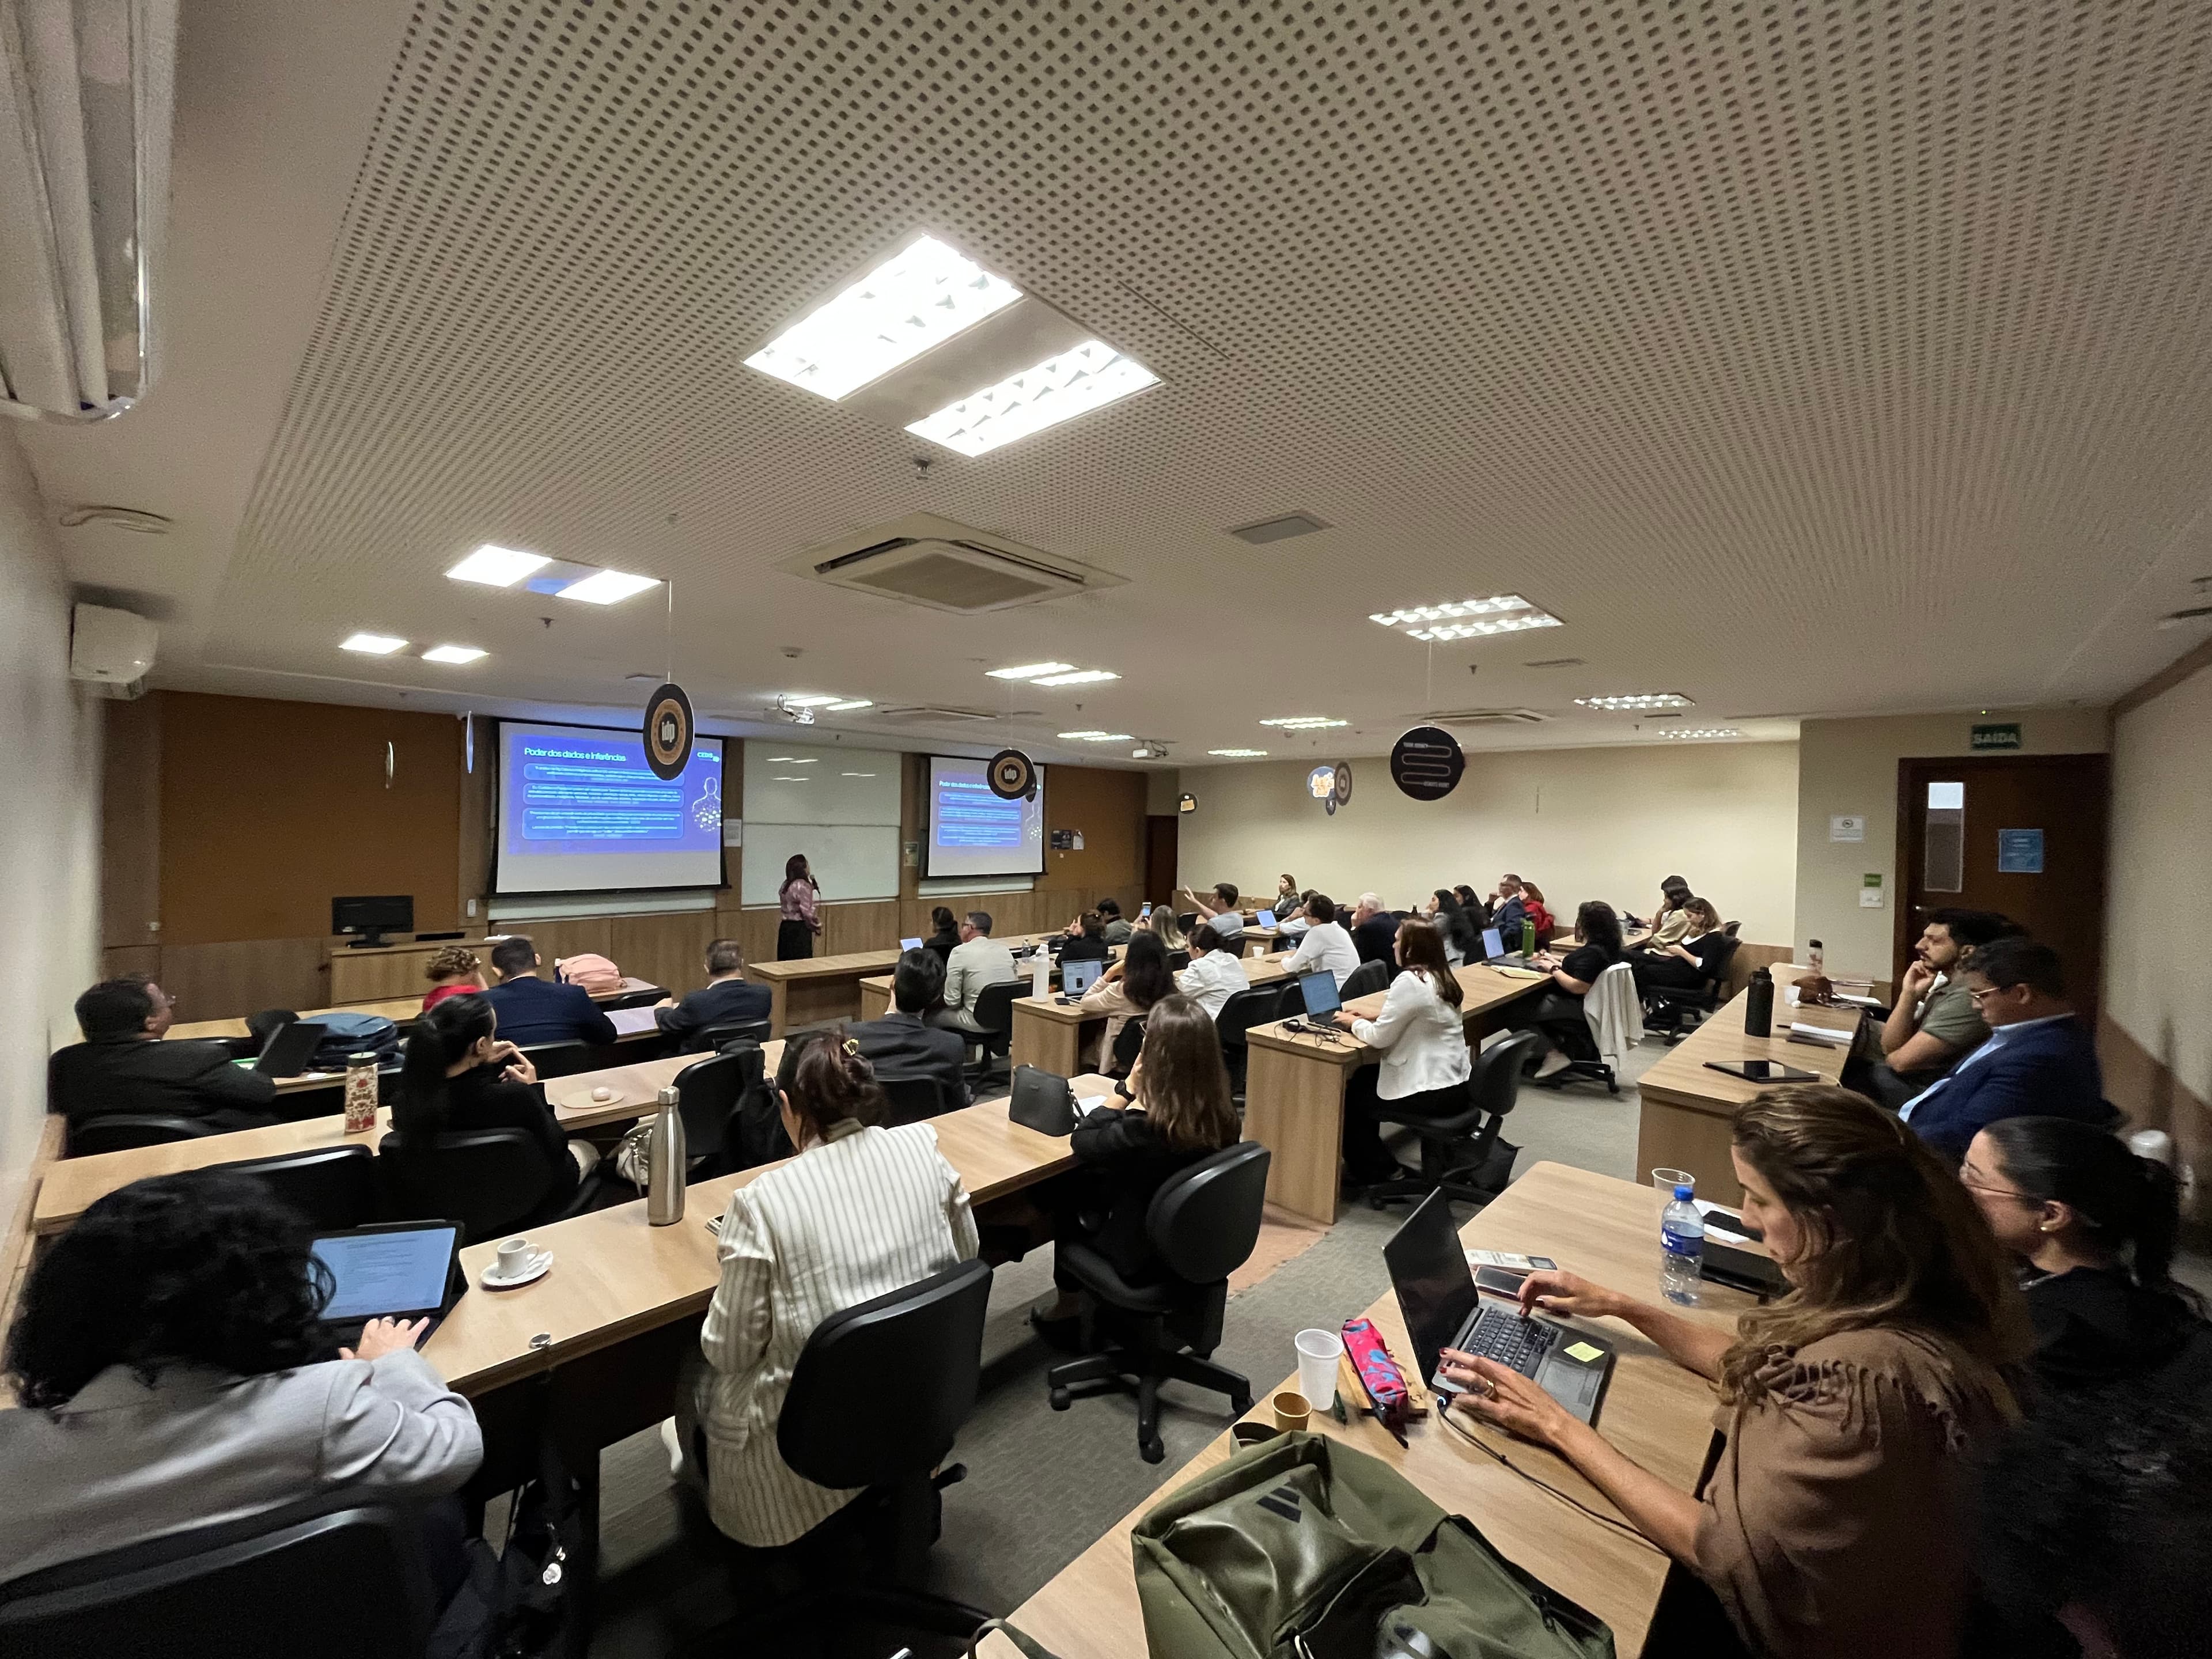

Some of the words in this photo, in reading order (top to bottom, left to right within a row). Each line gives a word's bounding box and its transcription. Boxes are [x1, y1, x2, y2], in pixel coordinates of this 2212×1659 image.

[524, 748, 547, 756] Poder
[548, 749, 562, 757] dos
[562, 751, 585, 759] dados
